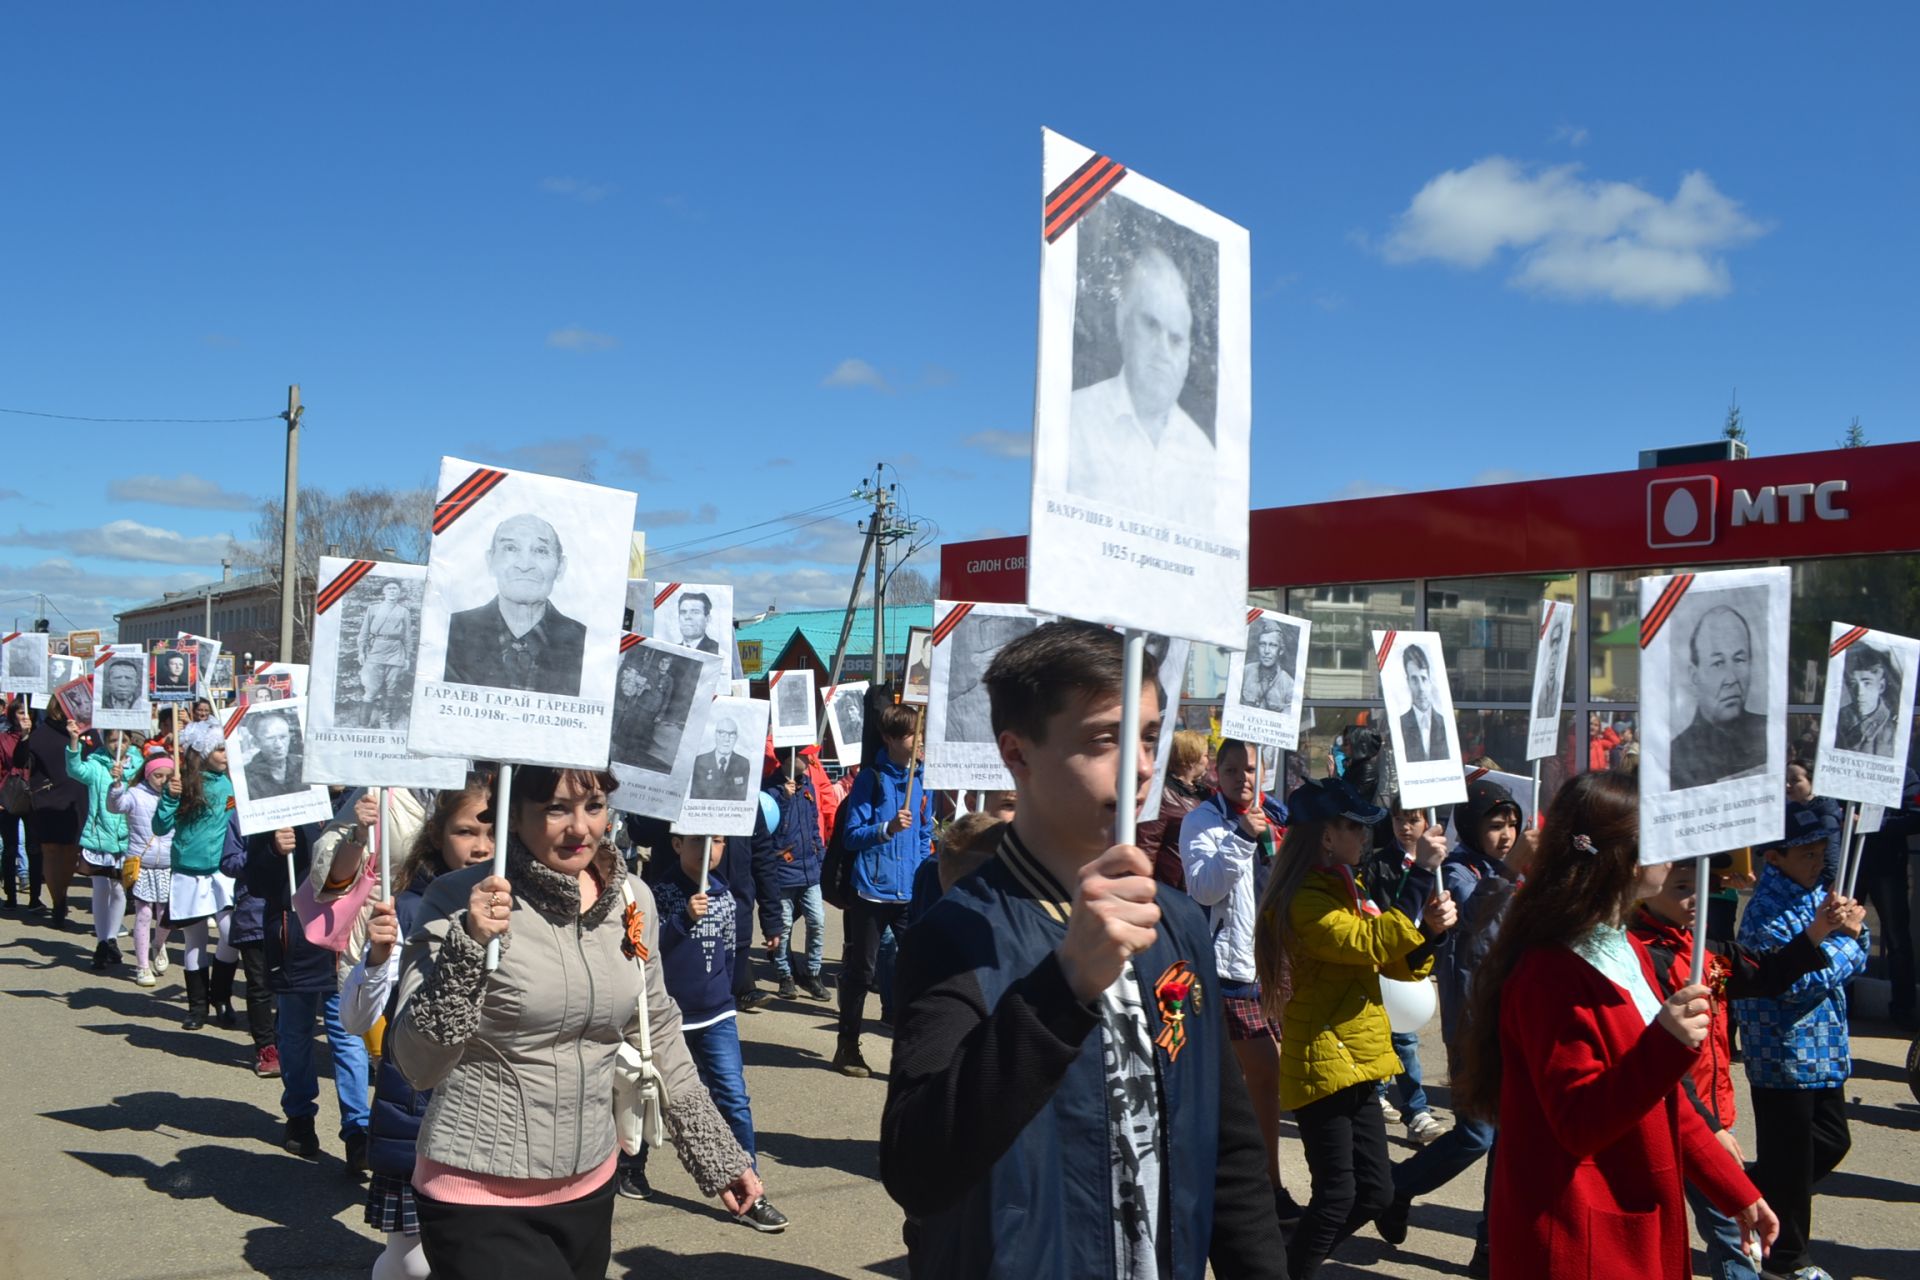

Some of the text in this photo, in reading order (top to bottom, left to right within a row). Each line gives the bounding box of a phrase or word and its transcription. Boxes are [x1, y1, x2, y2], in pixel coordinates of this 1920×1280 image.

[1731, 480, 1848, 526] МТС
[1046, 500, 1113, 528] ВАХРУШЕВ
[1118, 520, 1170, 544] АЛЕКСЕЙ
[1101, 541, 1128, 560] 1925
[424, 686, 606, 717] ГАРАЕВ ГАРАЙ ГАРЕЕВИЧ
[439, 704, 510, 723] 25.10.1918г.
[522, 712, 588, 730] 07.03.2005г.
[315, 732, 385, 744] НИЗАМБИЕВ
[353, 750, 373, 759] 1910
